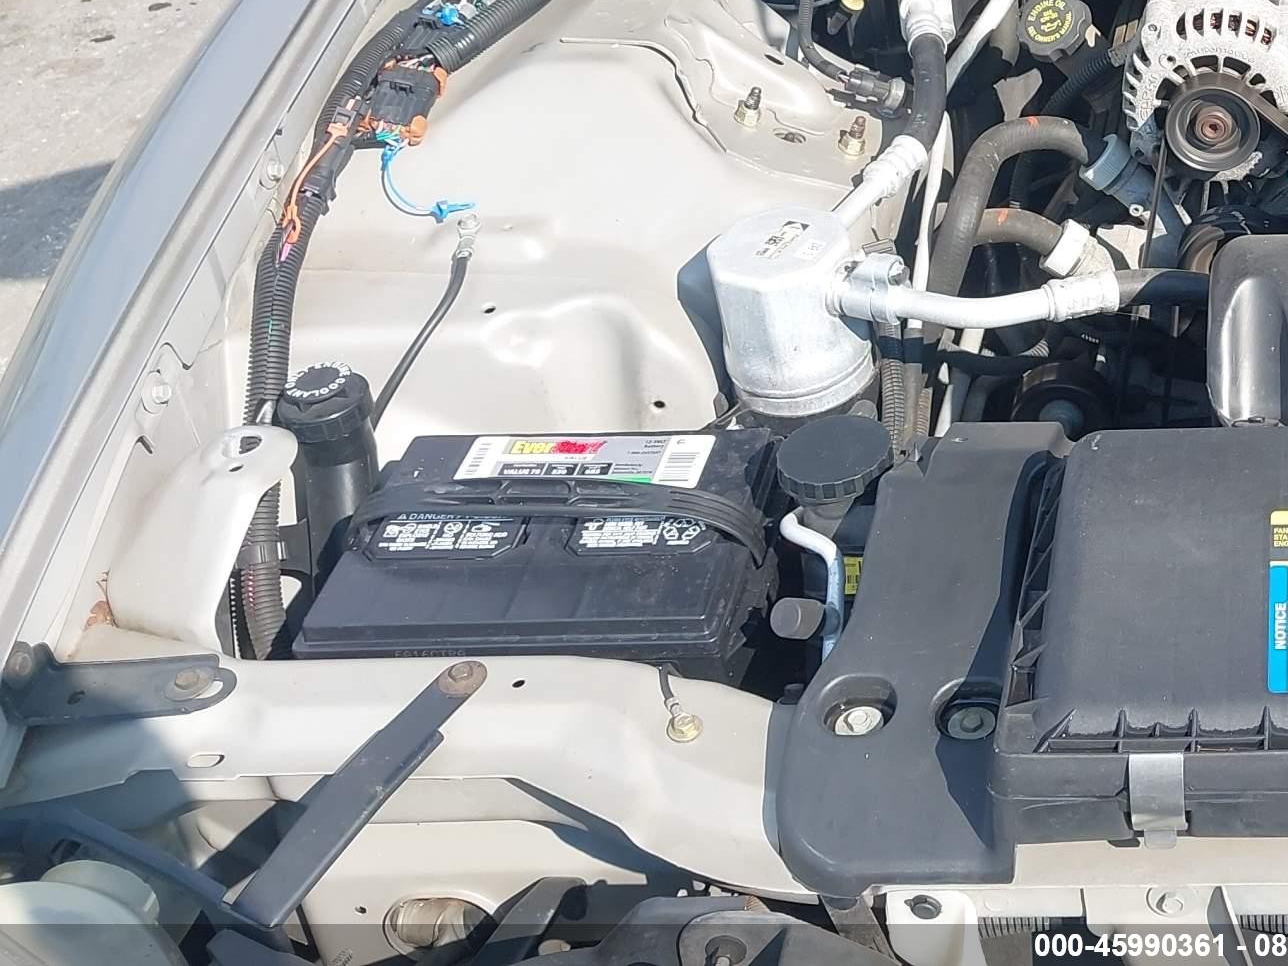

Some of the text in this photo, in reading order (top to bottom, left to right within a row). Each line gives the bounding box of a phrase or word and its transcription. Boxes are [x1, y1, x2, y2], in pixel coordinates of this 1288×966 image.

[314, 361, 351, 376] ENGINE
[286, 377, 346, 398] COOLANT
[1274, 602, 1287, 650] NOTICE
